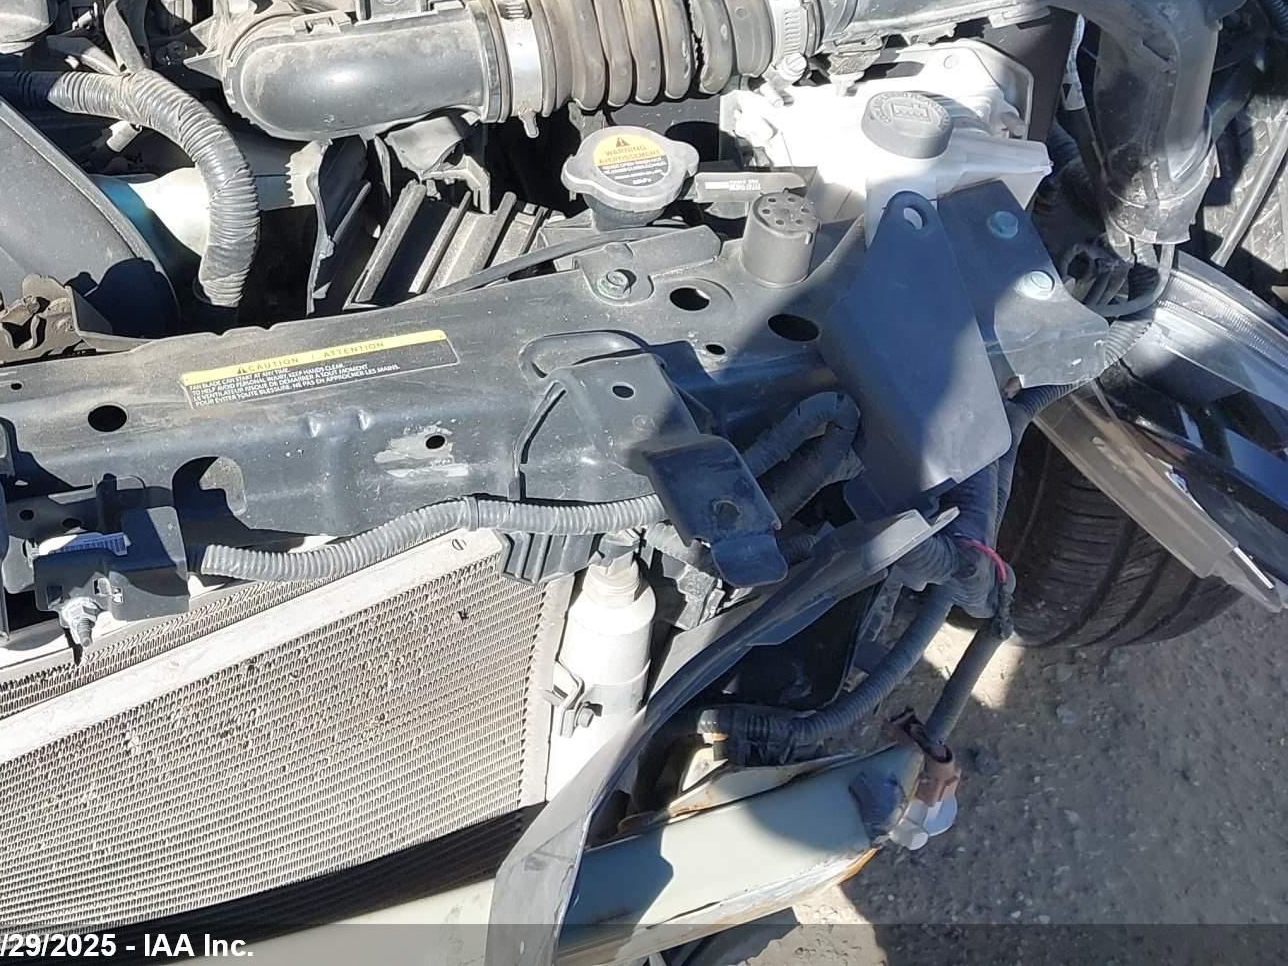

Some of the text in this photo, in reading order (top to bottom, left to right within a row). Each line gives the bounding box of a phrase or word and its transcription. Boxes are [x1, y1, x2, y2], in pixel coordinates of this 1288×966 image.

[605, 144, 647, 157] WARNING
[250, 358, 298, 370] CAUTION
[324, 343, 384, 358] ATTENTION
[201, 386, 215, 394] HELP
[217, 383, 234, 391] AVOID
[237, 377, 266, 387] PERSONAL
[303, 366, 324, 374] HANDS
[202, 387, 243, 400] VENTILATEUR
[321, 369, 337, 377] TOUT
[234, 374, 251, 382] START
[195, 398, 214, 406] POUR
